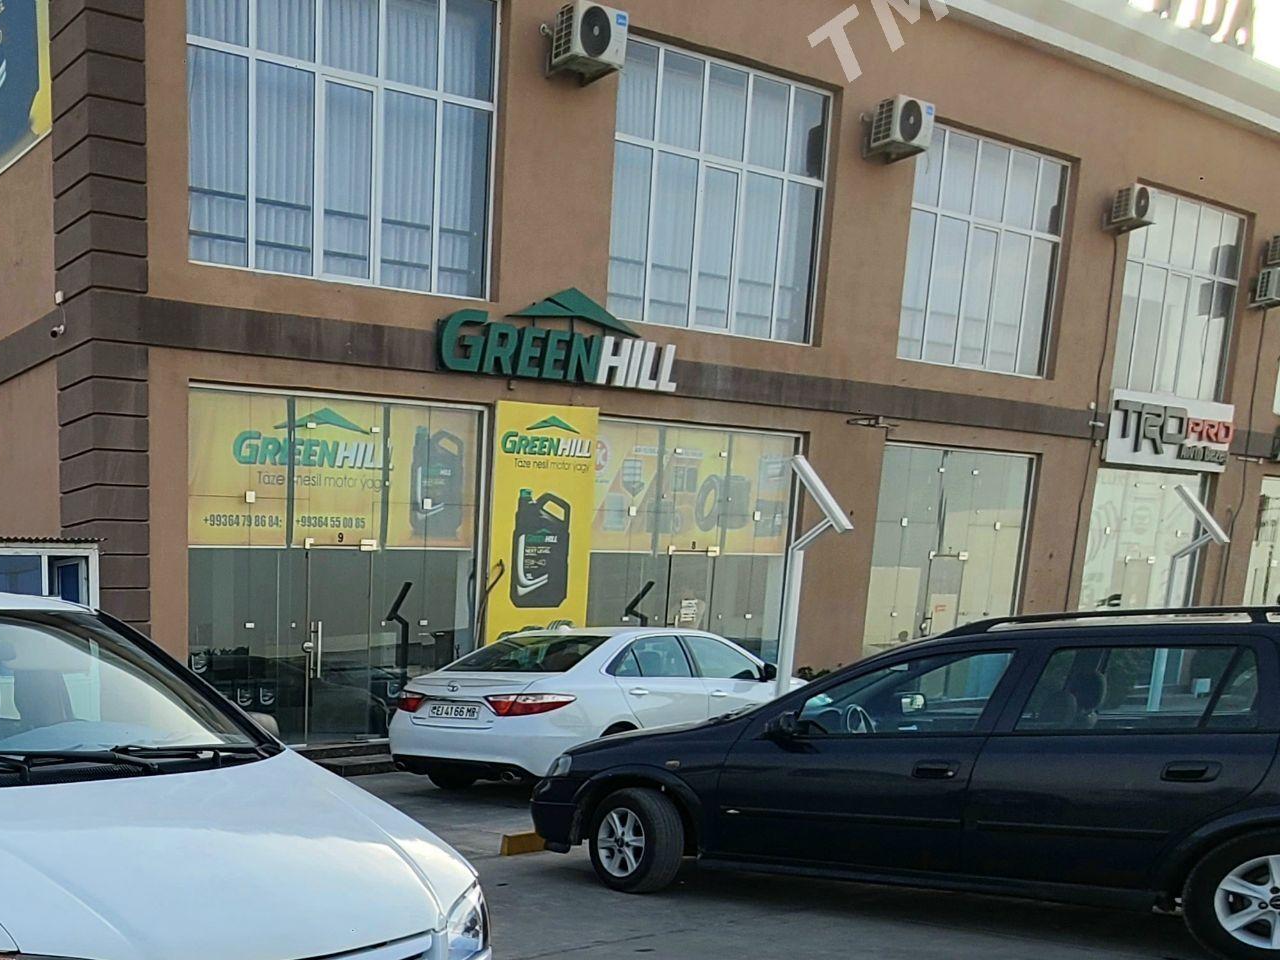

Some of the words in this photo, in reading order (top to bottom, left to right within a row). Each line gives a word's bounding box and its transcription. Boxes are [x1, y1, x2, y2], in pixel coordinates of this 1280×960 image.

[439, 308, 677, 393] GREENHILL
[501, 431, 592, 458] GREENHILL
[295, 473, 321, 486] nesil
[203, 515, 240, 527] +99364
[241, 515, 252, 527] 79
[254, 515, 266, 528] 86
[295, 516, 329, 528] +99364
[330, 516, 340, 528] 55
[342, 517, 353, 528] 00
[354, 517, 365, 528] 85
[338, 532, 344, 543] 9
